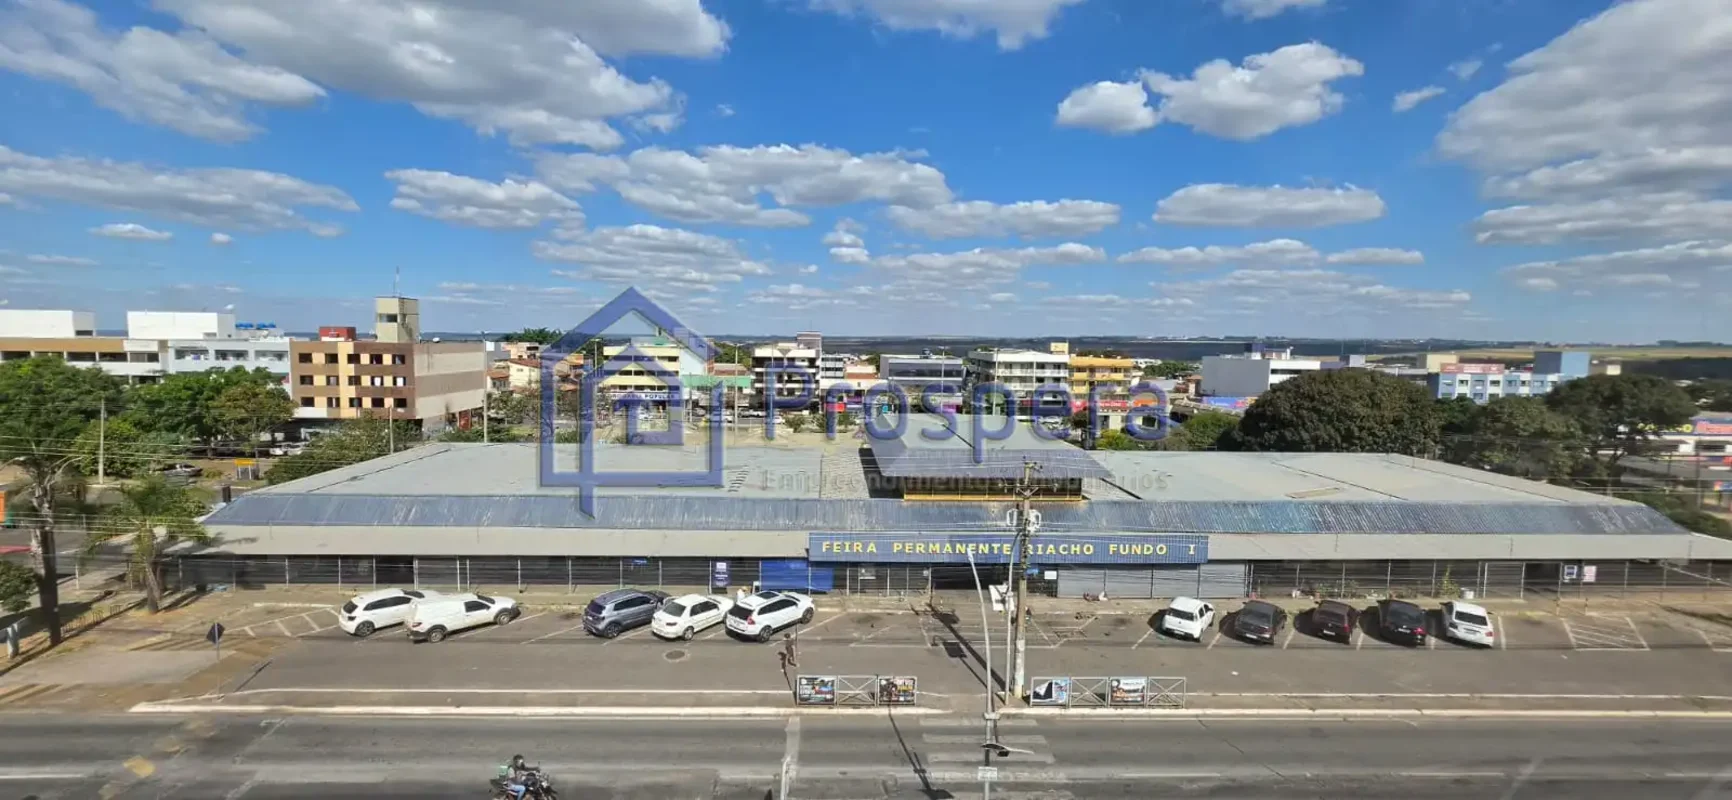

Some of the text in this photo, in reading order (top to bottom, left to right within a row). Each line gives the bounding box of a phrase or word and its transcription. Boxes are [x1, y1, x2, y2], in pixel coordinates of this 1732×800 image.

[822, 541, 877, 553] FEIRA
[893, 542, 1012, 555] PERMANENTE
[1026, 543, 1095, 556] RIACHO
[1109, 544, 1168, 555] FUNDO
